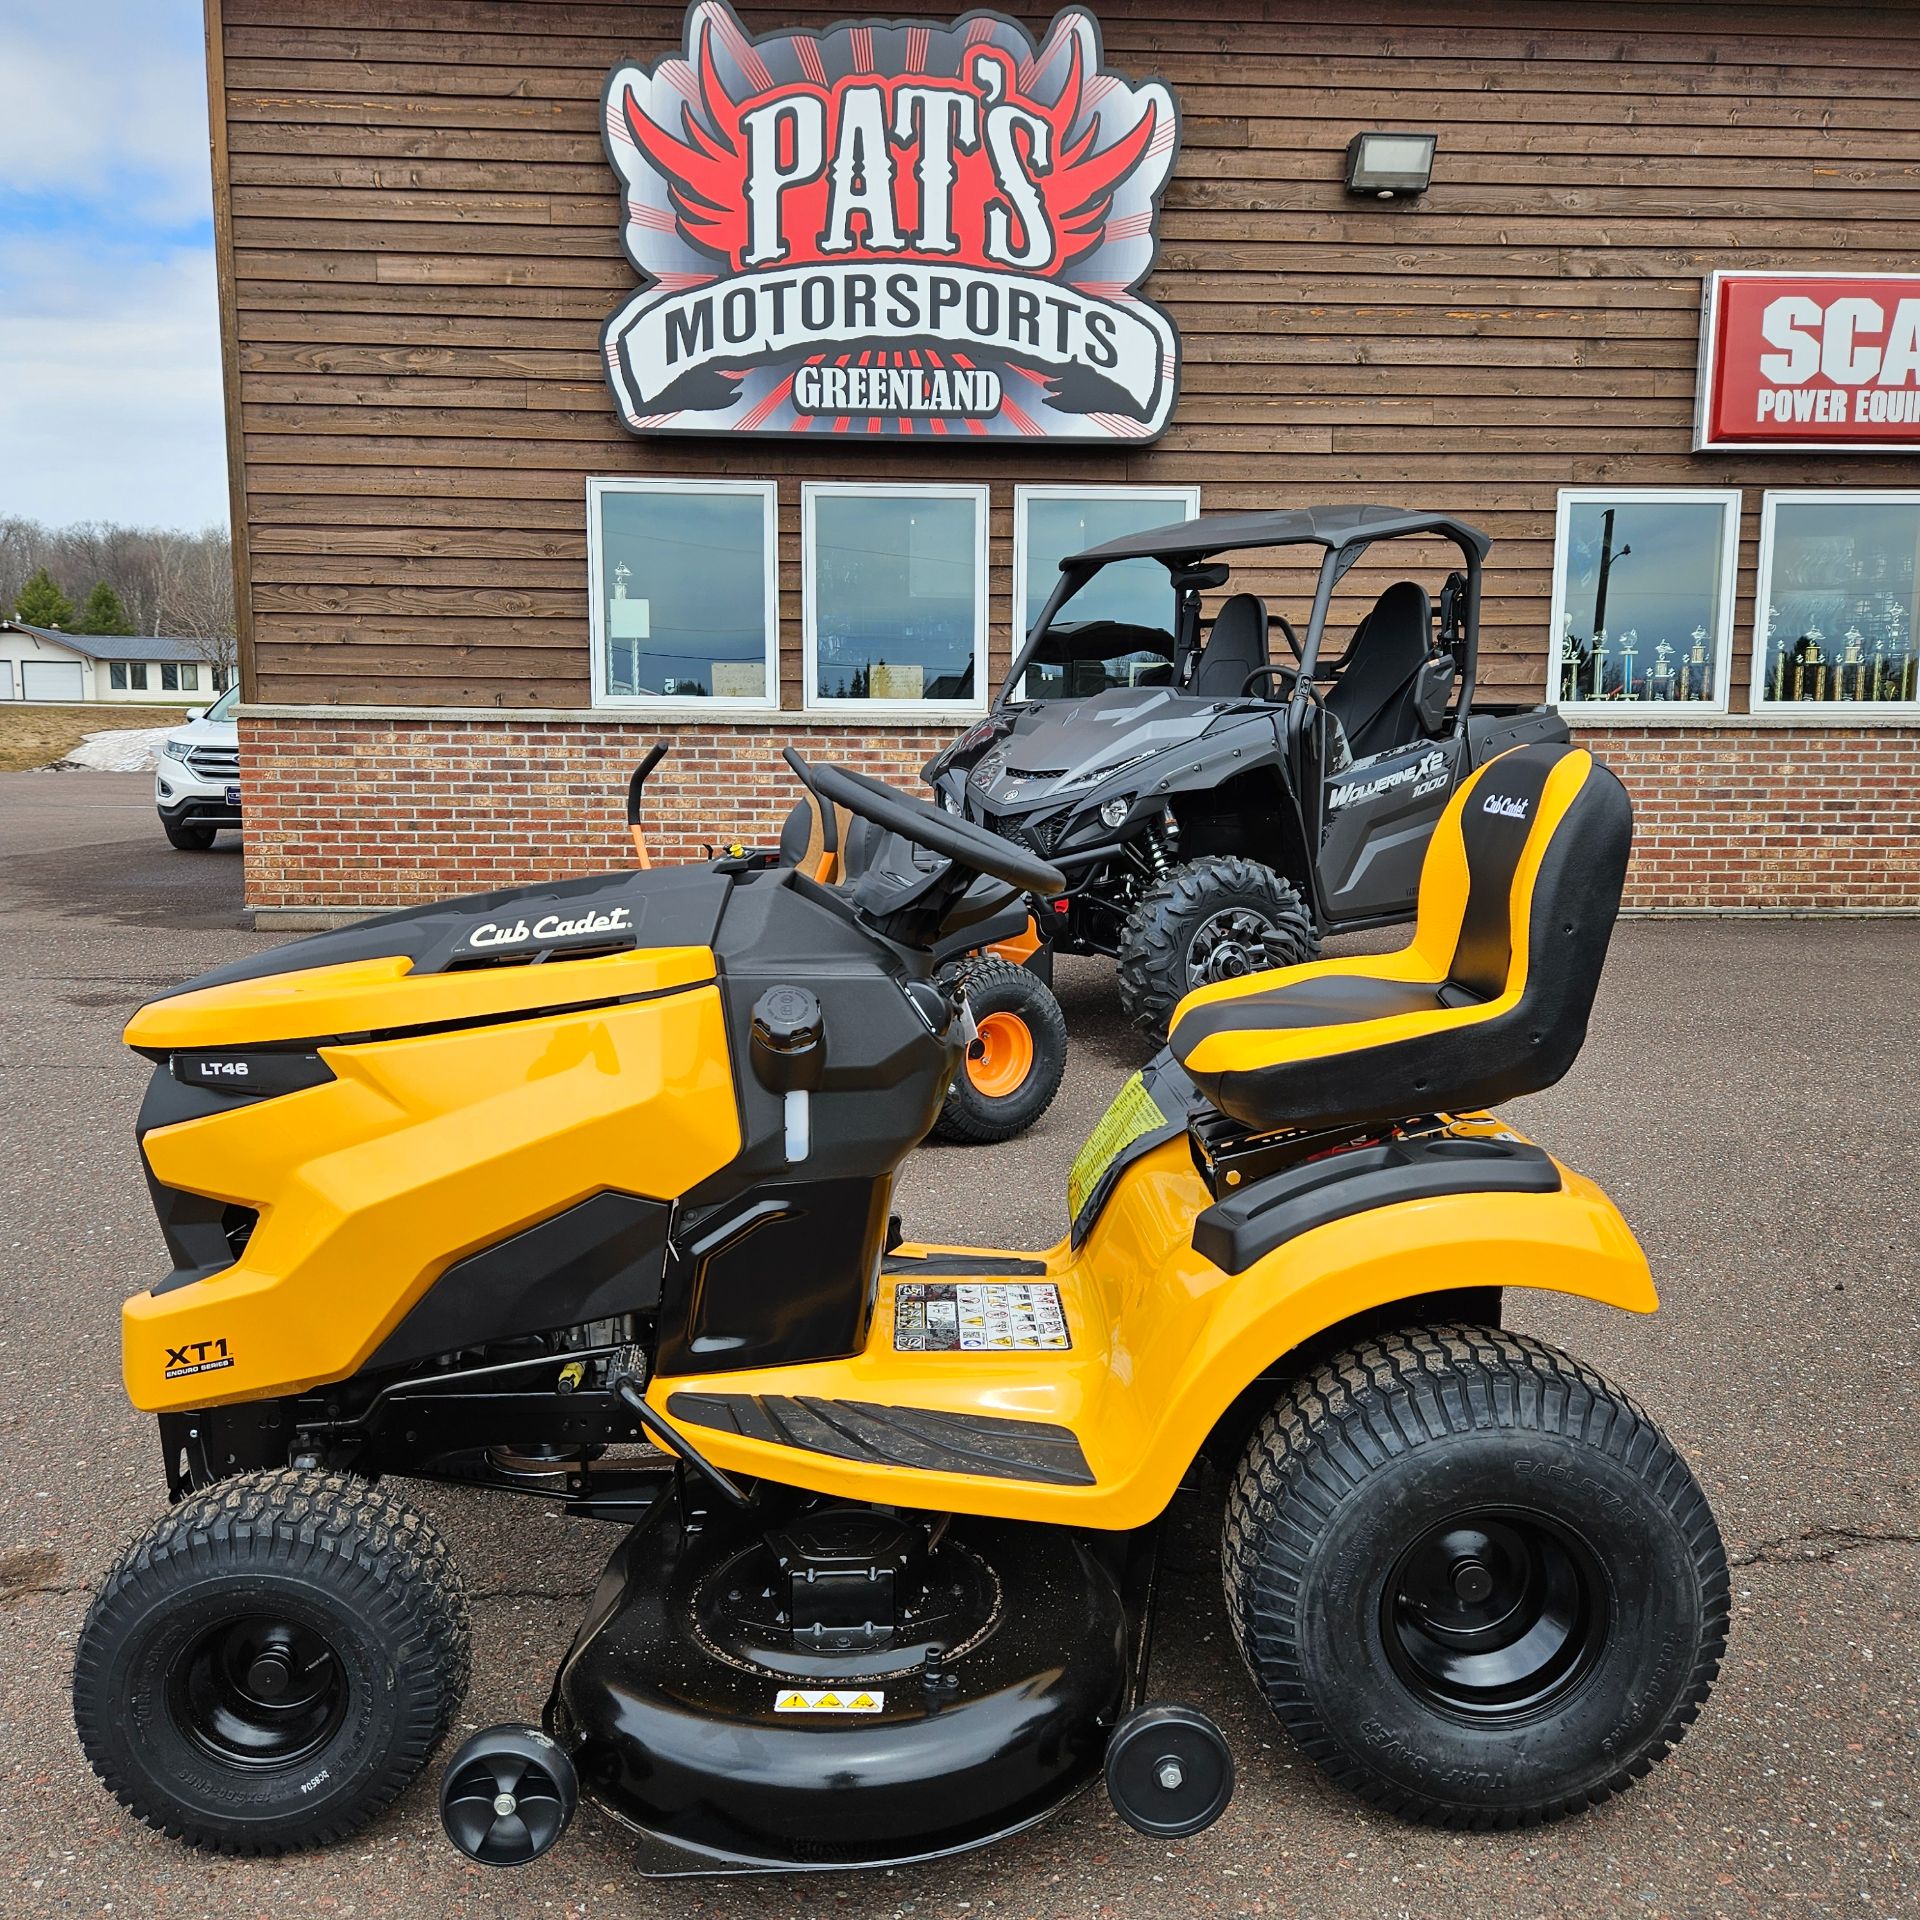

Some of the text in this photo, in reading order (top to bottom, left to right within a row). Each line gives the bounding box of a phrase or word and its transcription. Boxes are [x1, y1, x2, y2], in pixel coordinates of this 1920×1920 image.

[745, 57, 1054, 268] PAT'S
[664, 273, 1119, 368] MOTORSPORTS
[798, 366, 1001, 411] GREENLAND
[1756, 389, 1848, 423] POWER
[1328, 750, 1445, 810] WOLVERINE X2
[1412, 773, 1449, 799] 1000
[469, 907, 630, 948] Cub Cadet
[200, 1062, 249, 1076] LT46
[164, 1338, 228, 1368] XT1
[166, 1366, 199, 1378] ENDURO
